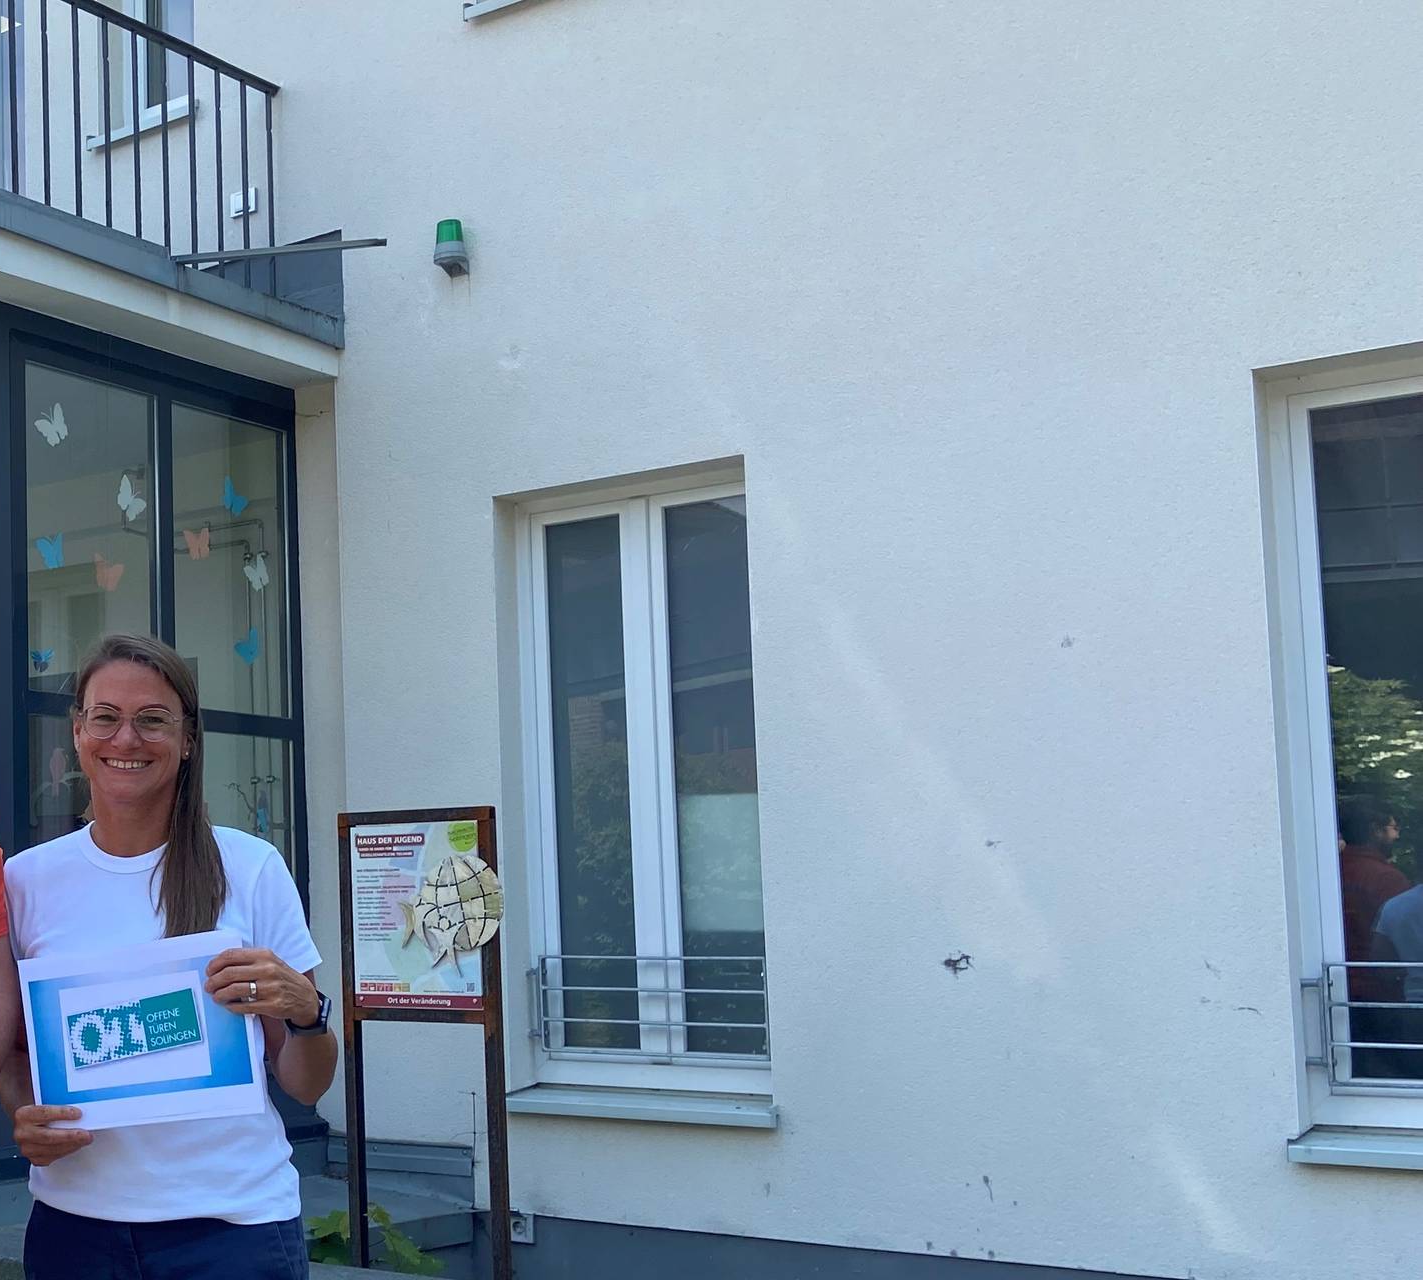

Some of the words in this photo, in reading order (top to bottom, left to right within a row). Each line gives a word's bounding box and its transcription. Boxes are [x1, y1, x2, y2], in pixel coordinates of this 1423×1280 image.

[394, 836, 423, 844] JUGEND
[410, 997, 451, 1006] Veränderung
[146, 1007, 180, 1023] OFFENE
[150, 1029, 197, 1047] SOLINGEN
